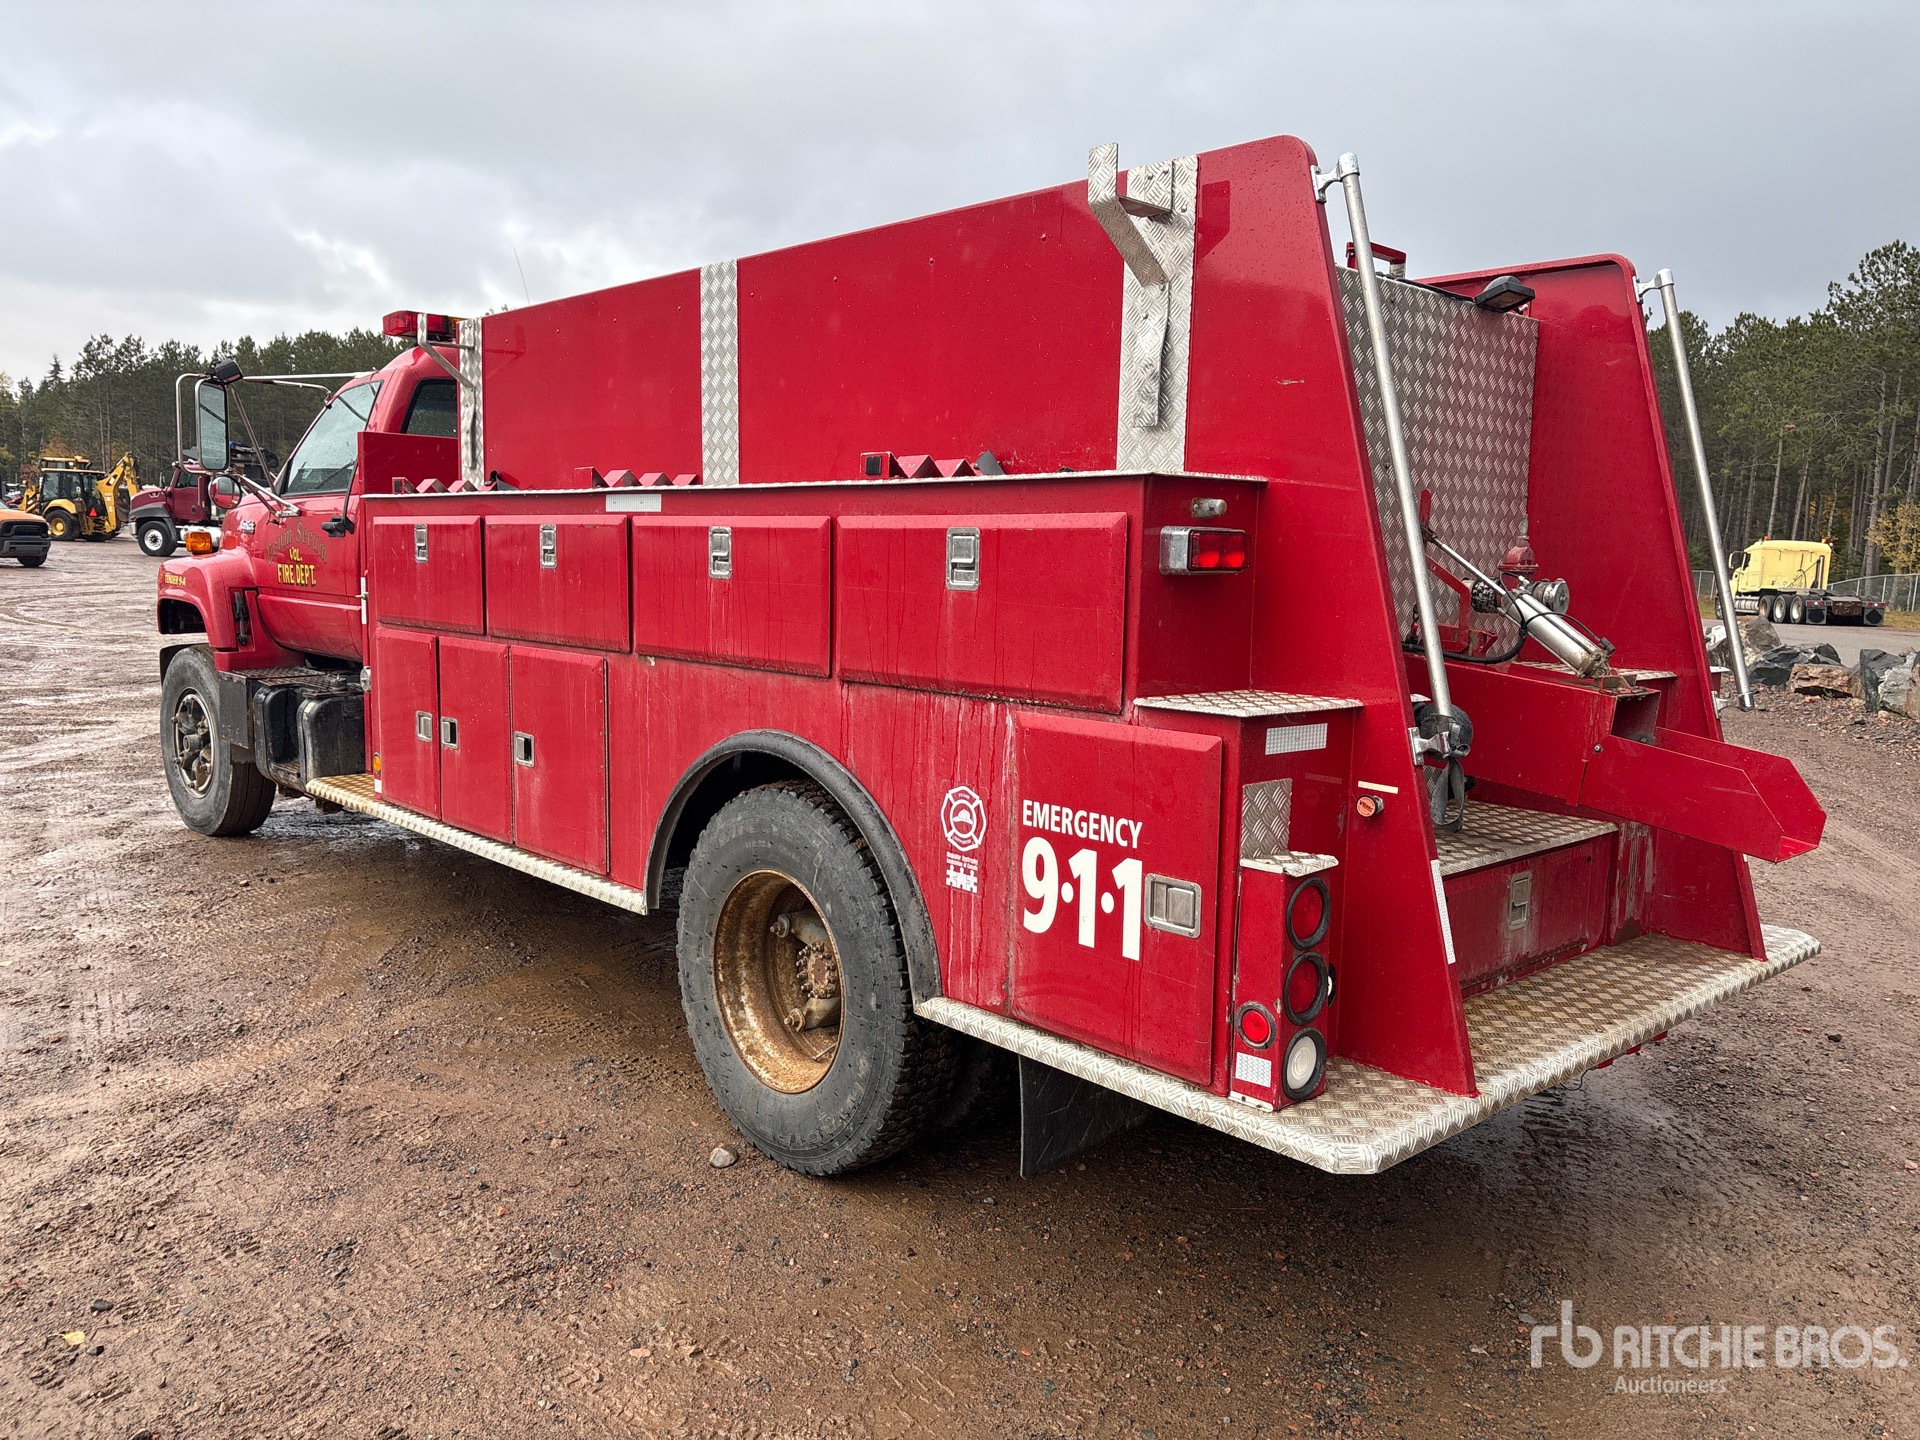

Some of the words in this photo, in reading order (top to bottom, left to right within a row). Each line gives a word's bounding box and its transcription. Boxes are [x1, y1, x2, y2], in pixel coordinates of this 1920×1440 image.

[295, 521, 328, 564] Secum
[277, 564, 295, 585] FIRE
[295, 564, 317, 587] DEPT.
[1022, 799, 1143, 849] EMERGENCY
